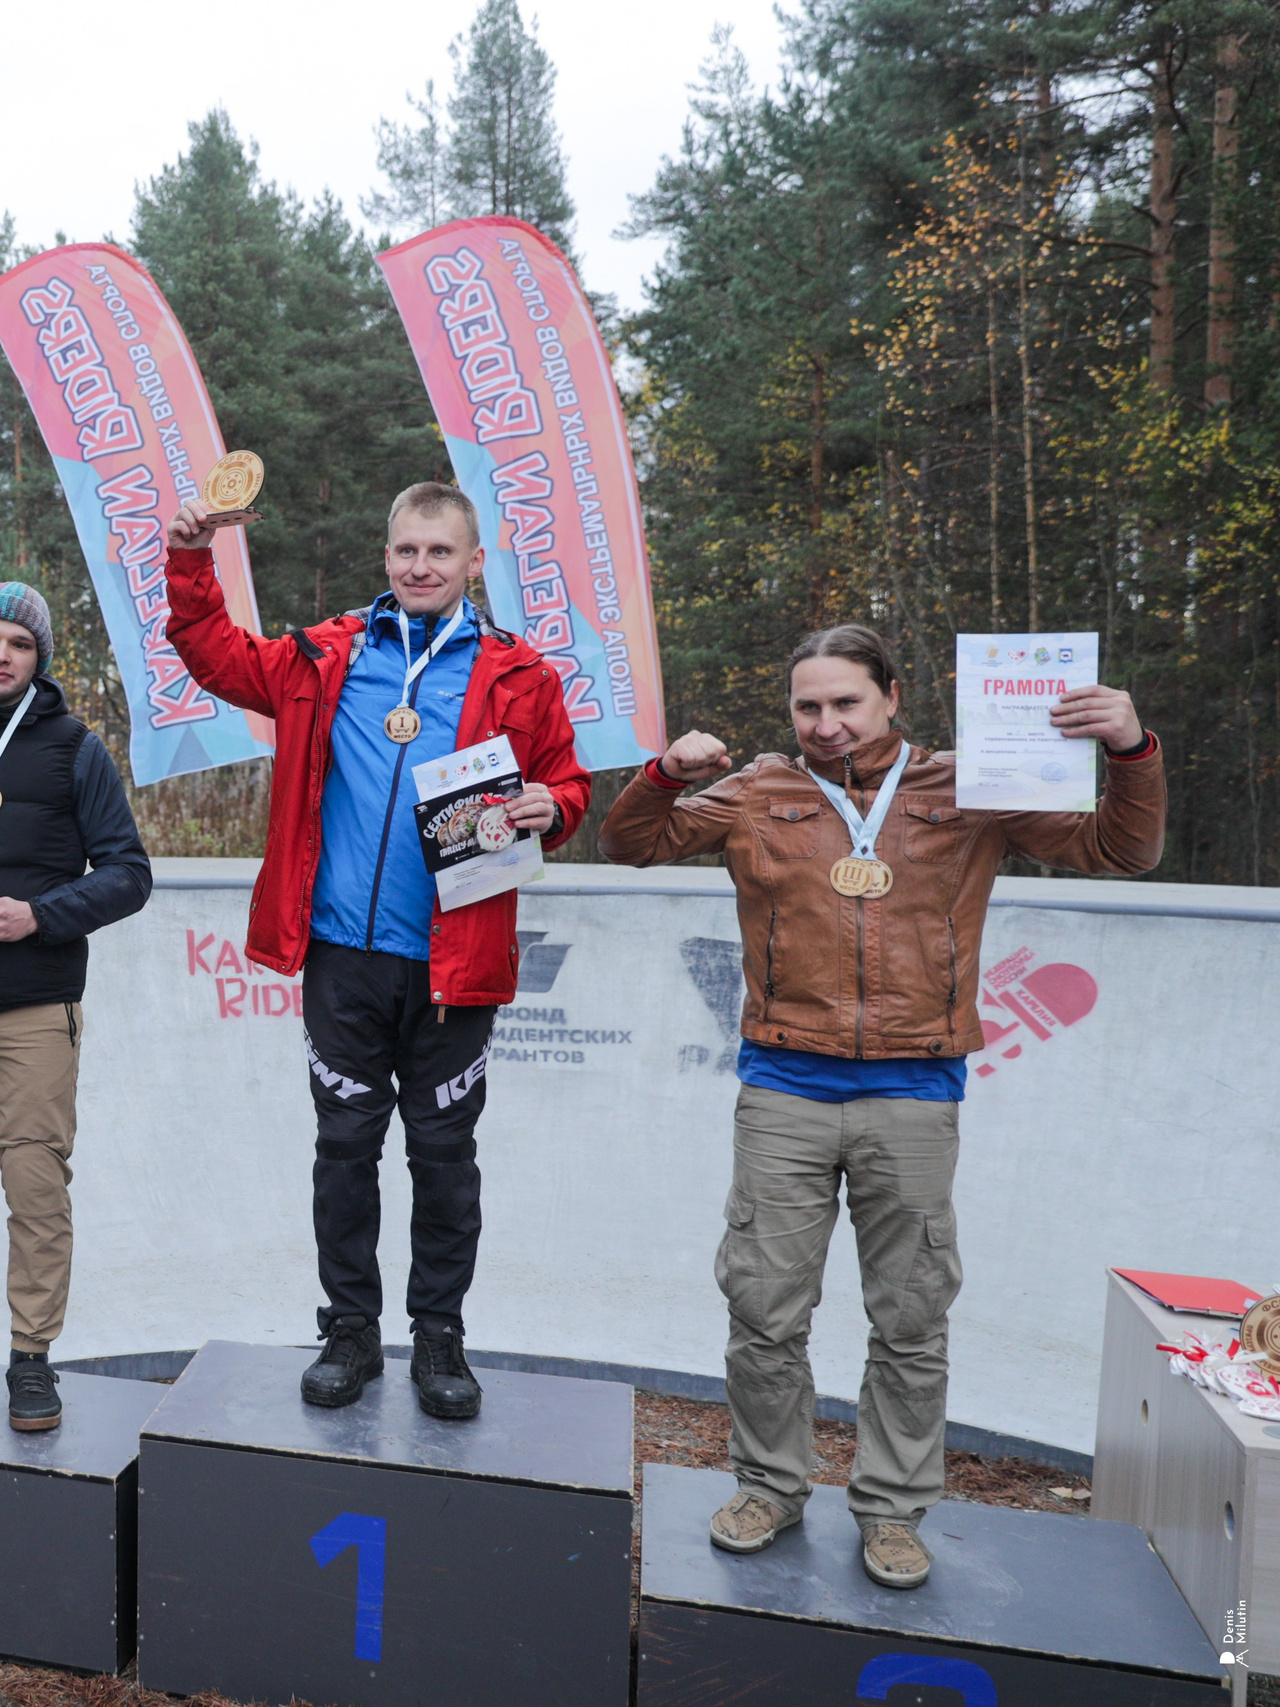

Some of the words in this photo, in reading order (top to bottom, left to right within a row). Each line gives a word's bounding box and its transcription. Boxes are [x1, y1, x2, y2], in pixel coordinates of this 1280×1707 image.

[983, 679, 1067, 696] ГРАМОТА
[215, 978, 303, 1019] RIDE
[497, 1006, 567, 1025] ФОНД
[1015, 989, 1057, 1027] КАРЕЛИЯ
[492, 1027, 632, 1044] ИДЕНТСКИХ
[492, 1047, 585, 1064] РАНТОВ
[1262, 1299, 1280, 1312] ФС
[309, 1512, 386, 1663] 1
